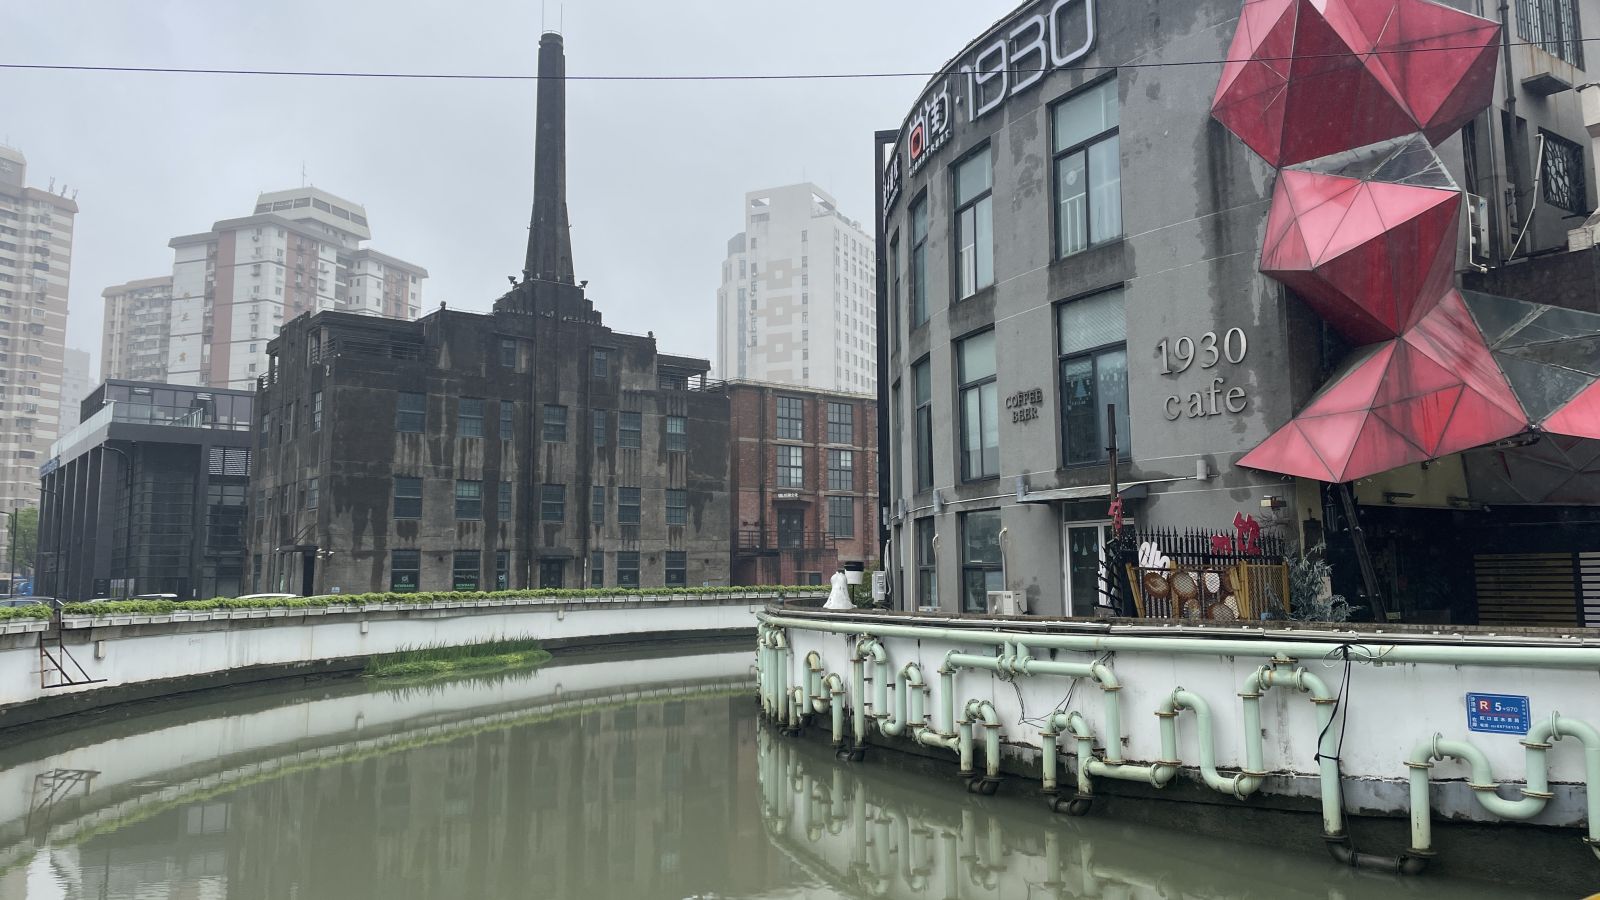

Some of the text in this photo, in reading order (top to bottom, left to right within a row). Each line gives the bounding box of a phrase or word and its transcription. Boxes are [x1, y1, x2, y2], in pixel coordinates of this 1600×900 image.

[959, 0, 1095, 122] 1930
[1157, 327, 1248, 376] 1930
[1005, 388, 1043, 409] COFFEE
[1163, 377, 1248, 421] cafe
[1012, 407, 1039, 424] BEER
[1479, 700, 1489, 710] R
